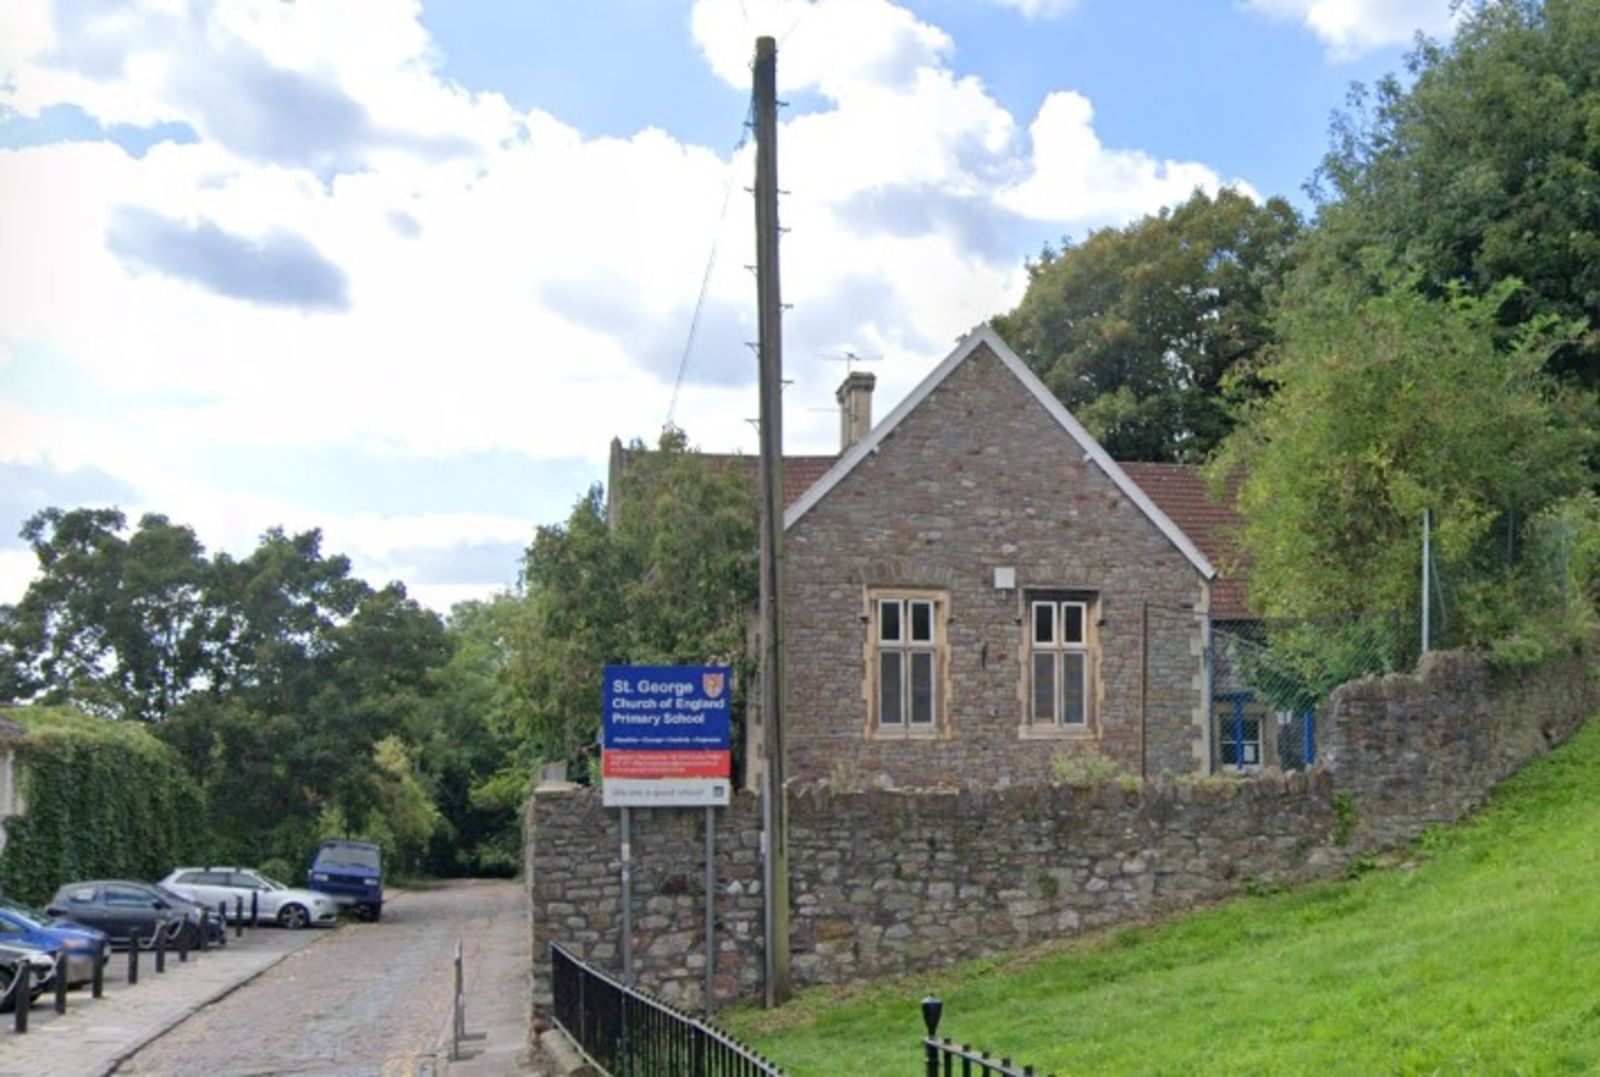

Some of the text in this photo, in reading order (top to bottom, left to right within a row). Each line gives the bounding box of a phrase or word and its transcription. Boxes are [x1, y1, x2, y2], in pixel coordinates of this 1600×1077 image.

[612, 680, 694, 697] St. George
[612, 698, 725, 711] Church of England
[612, 713, 705, 727] Primary School
